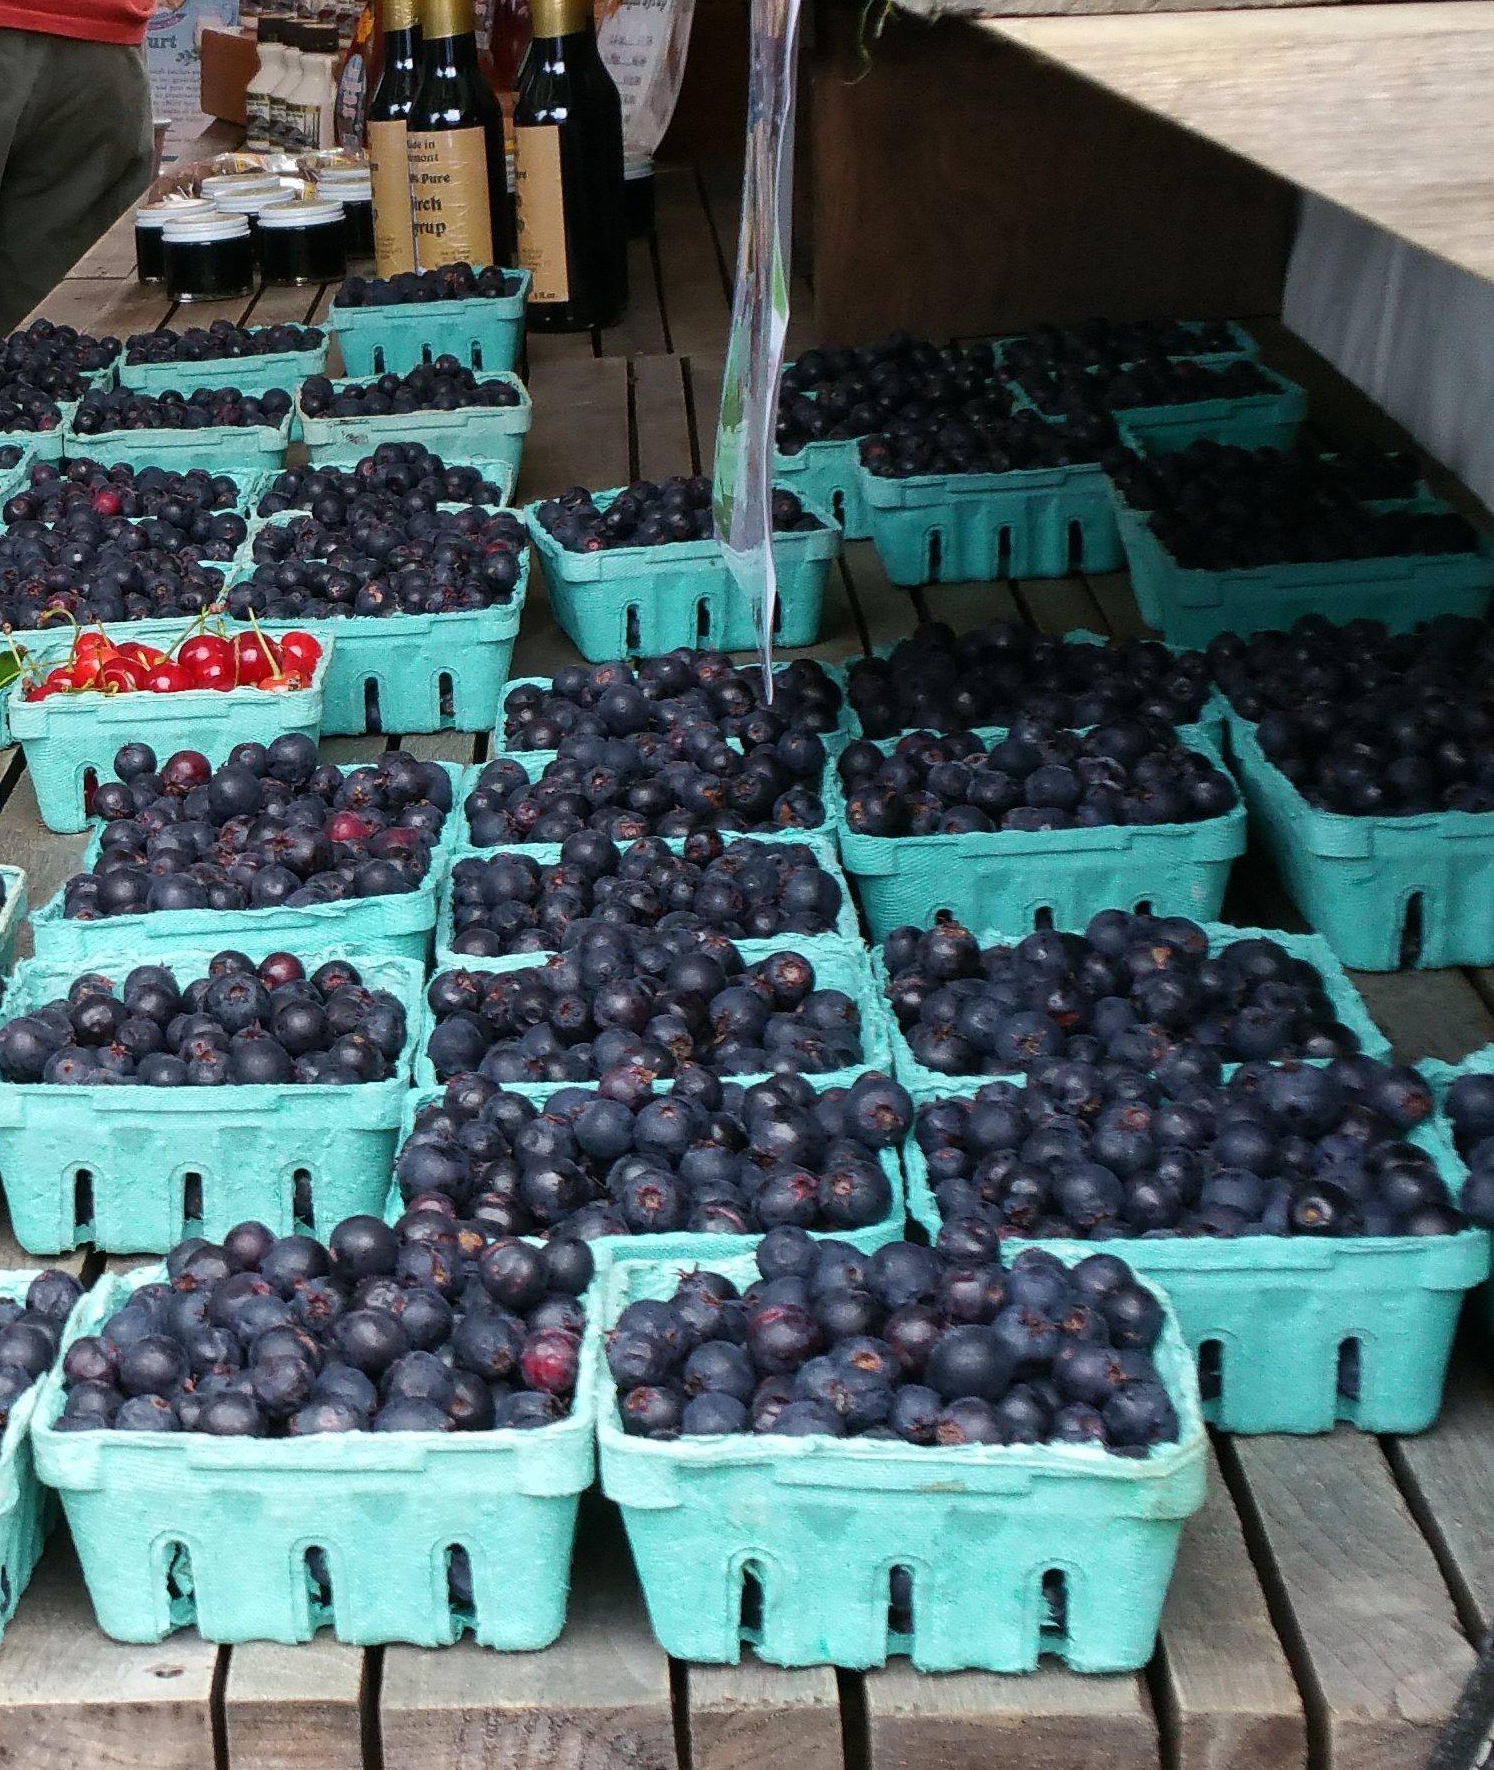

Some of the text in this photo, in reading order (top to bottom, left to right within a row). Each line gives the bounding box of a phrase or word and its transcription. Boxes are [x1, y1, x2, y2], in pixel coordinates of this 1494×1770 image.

[146, 34, 177, 49] urt
[424, 139, 435, 149] in
[421, 173, 451, 185] Pure
[412, 221, 447, 239] yrup
